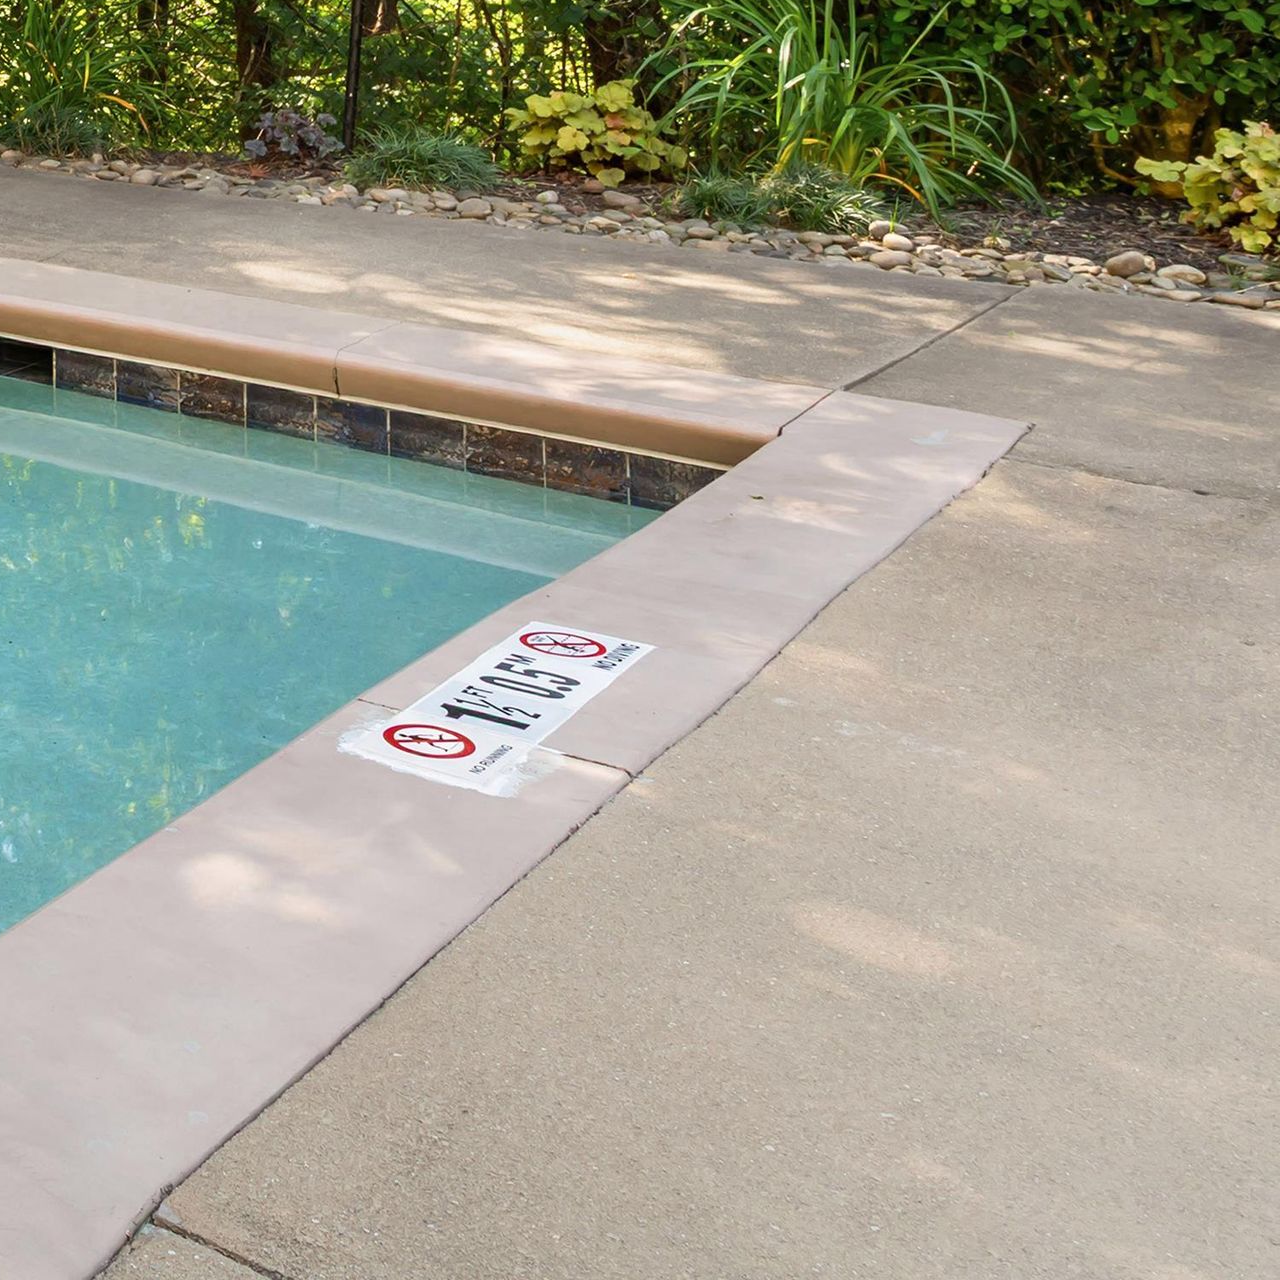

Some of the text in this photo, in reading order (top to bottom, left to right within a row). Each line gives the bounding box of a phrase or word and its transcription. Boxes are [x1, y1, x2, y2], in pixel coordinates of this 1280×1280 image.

[592, 643, 640, 671] NO DIVING
[469, 744, 513, 774] NO RUNNING
